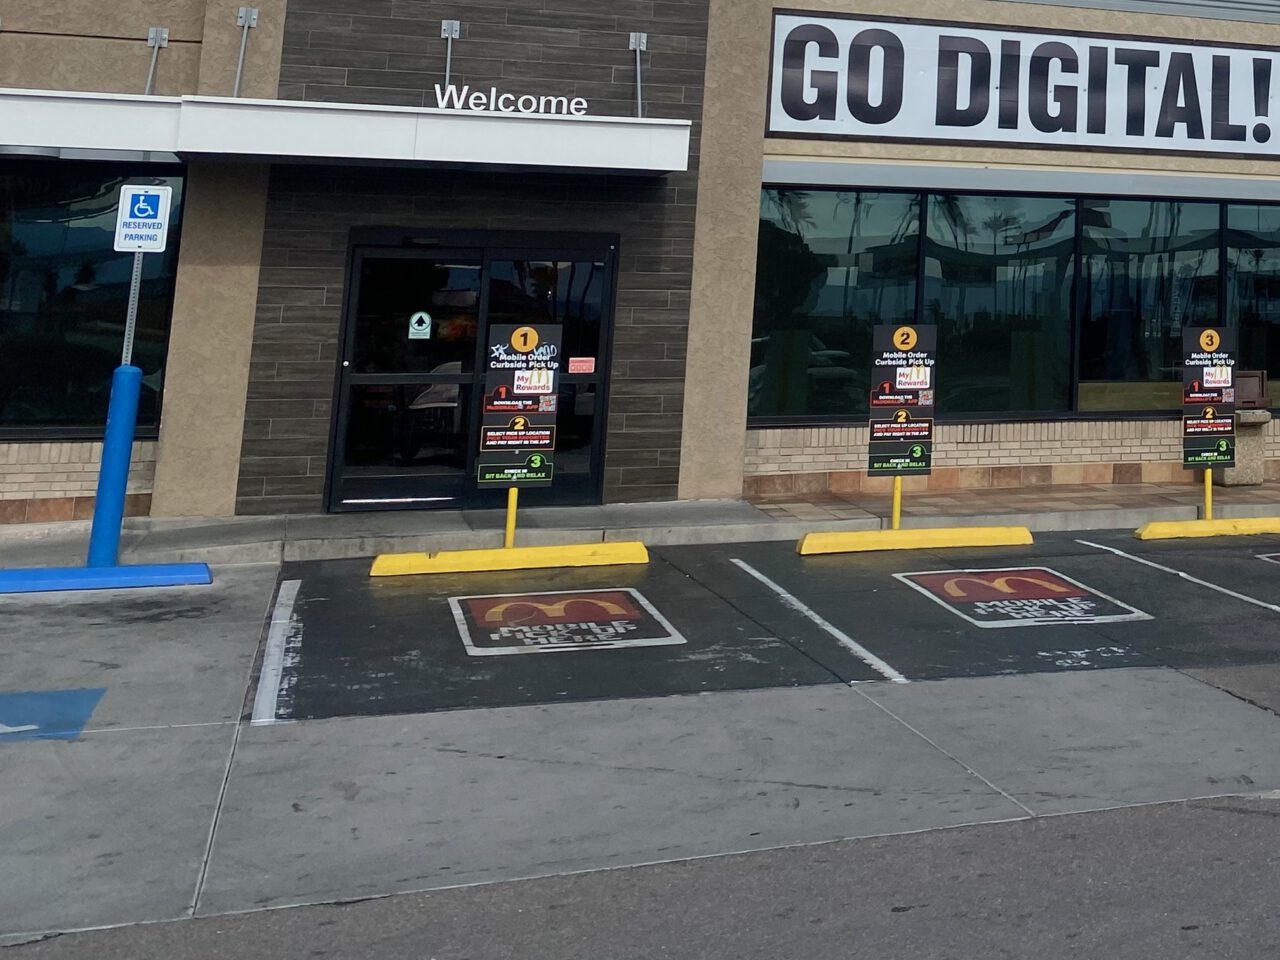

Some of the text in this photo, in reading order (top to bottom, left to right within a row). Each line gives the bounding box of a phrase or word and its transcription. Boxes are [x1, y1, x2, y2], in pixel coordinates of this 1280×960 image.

[781, 24, 904, 124] GO
[935, 35, 1272, 144] DIGITAL!
[434, 84, 587, 115] Welcome
[124, 233, 158, 241] PARKING
[520, 332, 528, 346] 1
[900, 332, 910, 345] 2
[1206, 334, 1214, 346] 3
[547, 361, 558, 369] Up
[516, 376, 529, 384] My
[499, 387, 506, 398] 1
[883, 383, 890, 394] 1
[1193, 382, 1198, 392] 1
[897, 412, 906, 422] 2
[1206, 408, 1214, 418] 2
[514, 418, 525, 430] 2
[1220, 440, 1226, 451] 3
[912, 446, 922, 458] 3
[531, 455, 541, 468] 3
